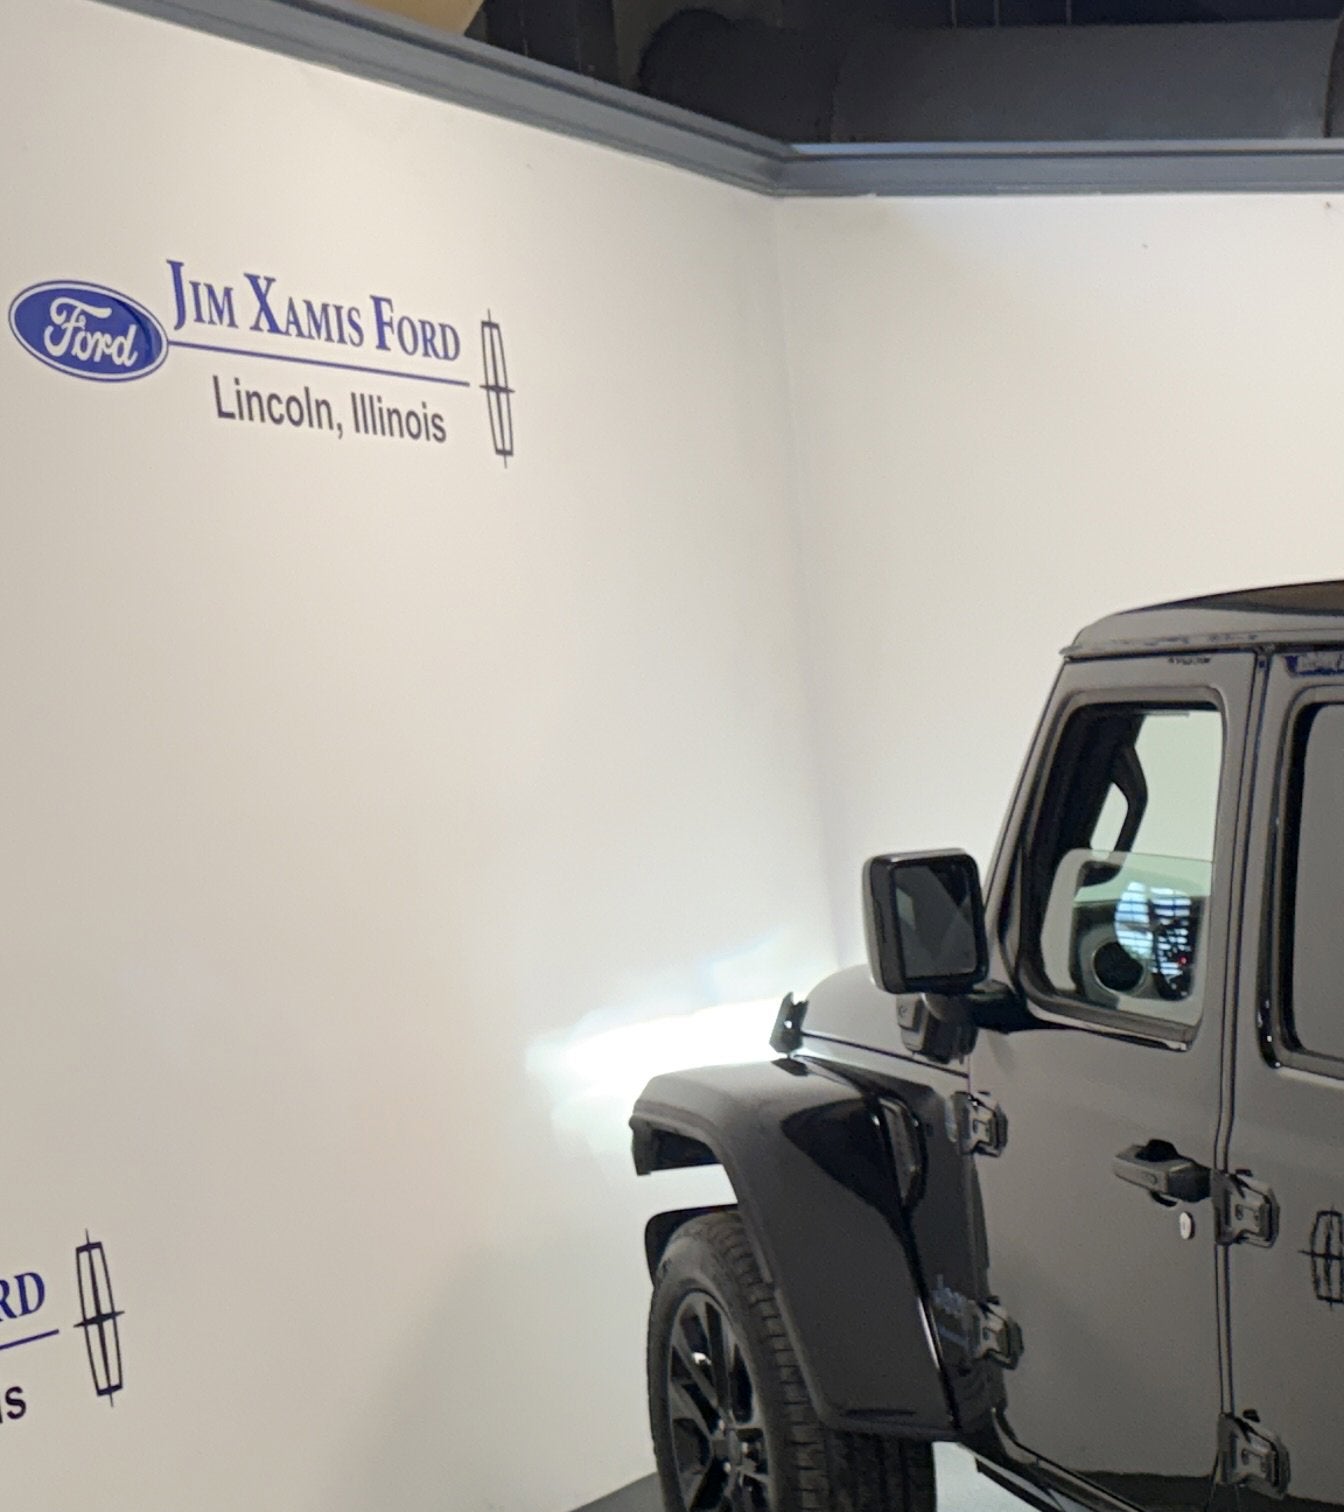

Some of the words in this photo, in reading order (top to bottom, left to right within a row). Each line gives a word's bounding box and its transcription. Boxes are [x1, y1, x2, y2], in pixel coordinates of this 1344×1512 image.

[43, 296, 139, 367] Ford
[166, 260, 239, 330] JIM
[243, 272, 365, 348] XAMIS
[369, 294, 461, 362] FORD
[212, 375, 344, 440] Lincoln,
[350, 391, 448, 443] Illinois
